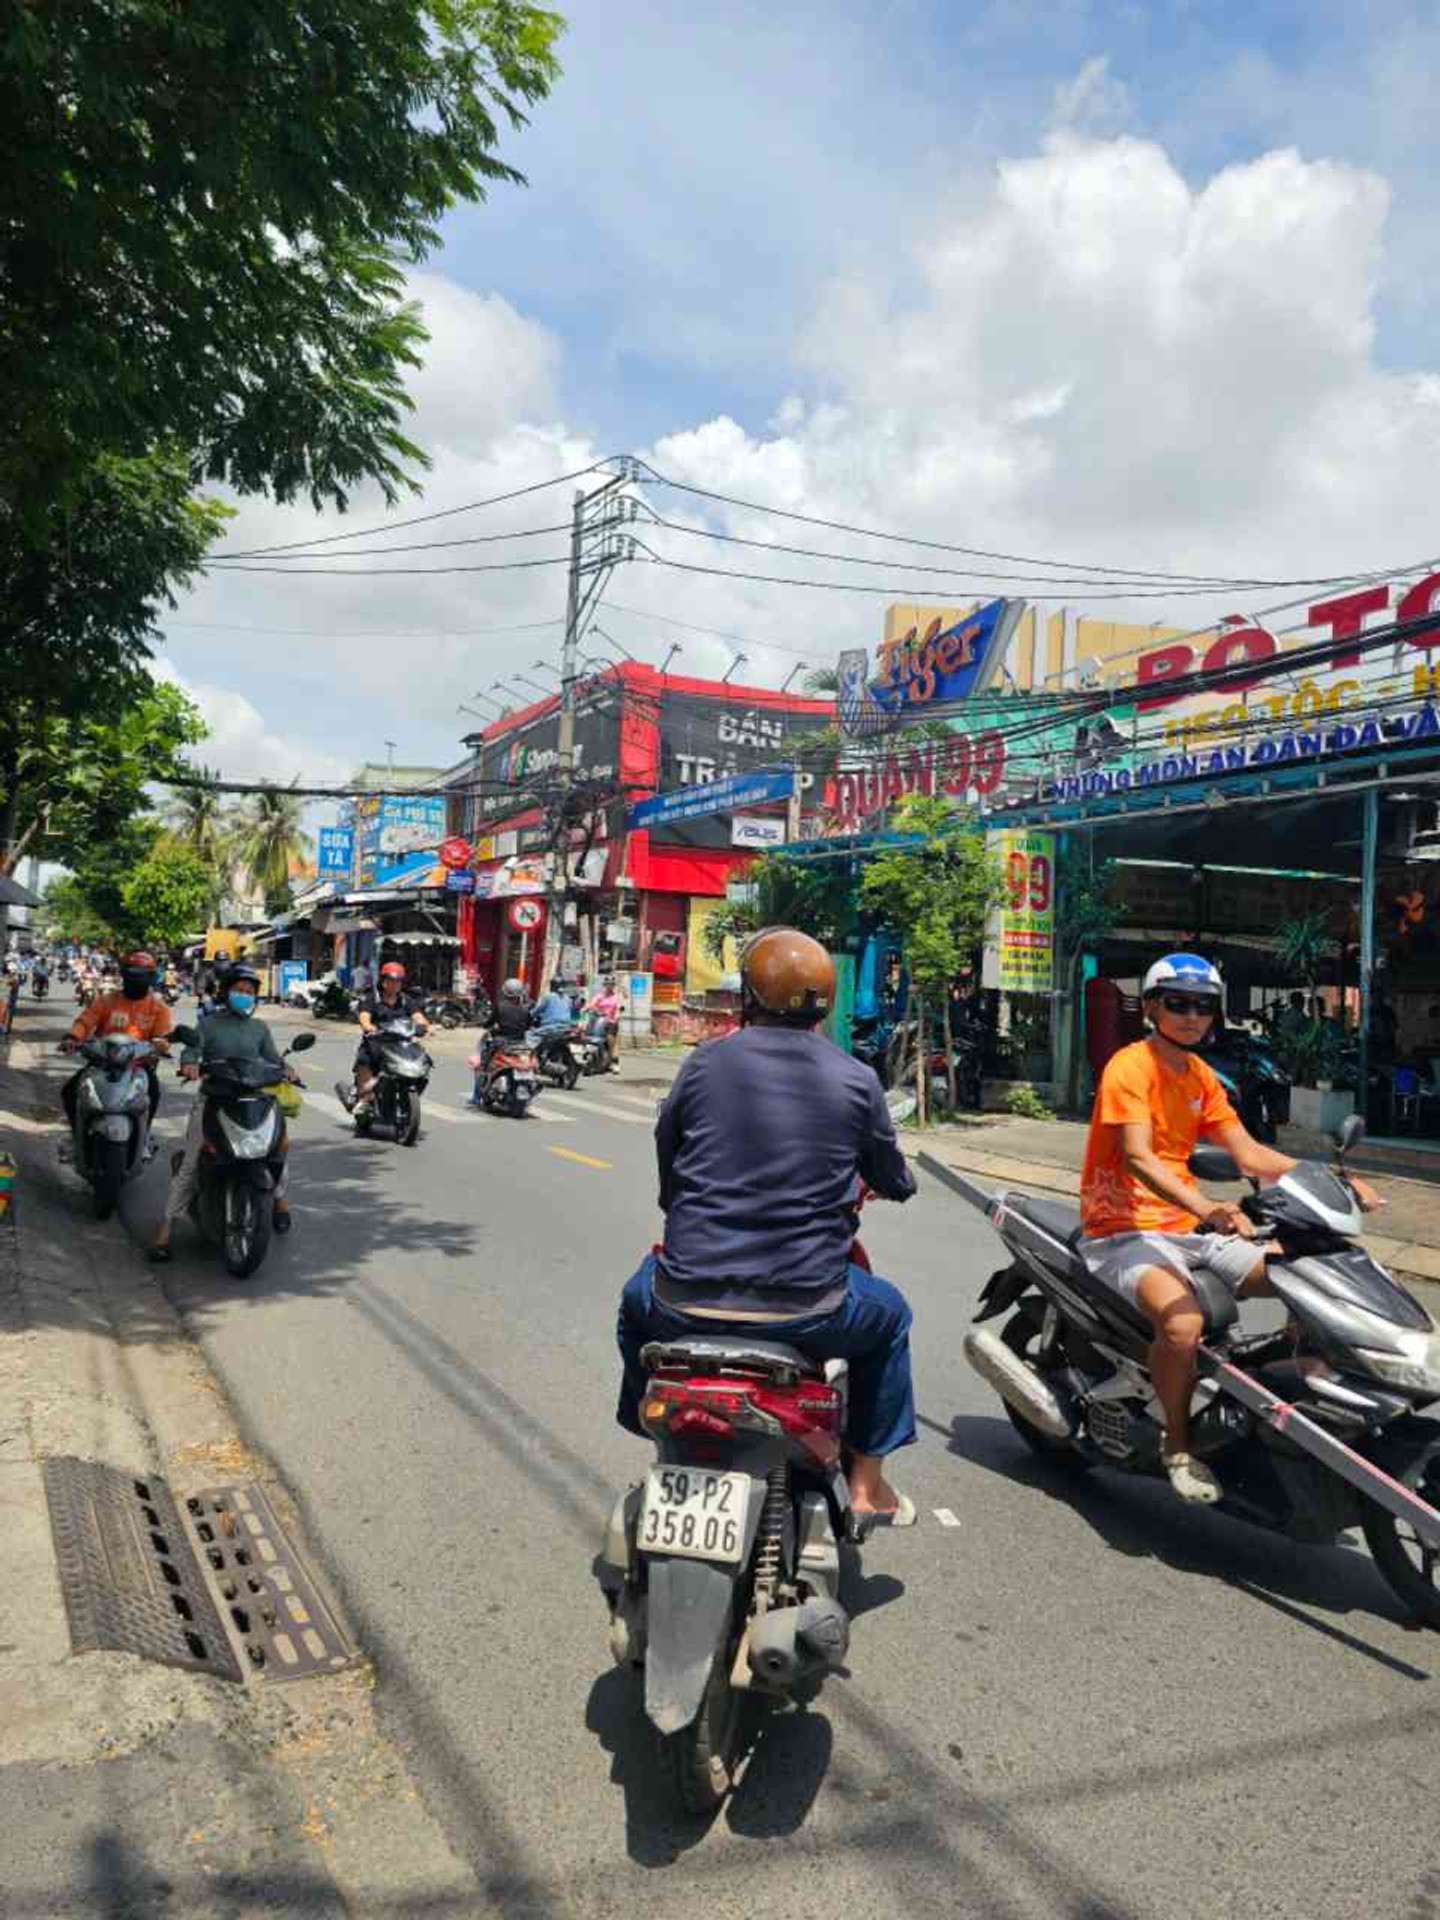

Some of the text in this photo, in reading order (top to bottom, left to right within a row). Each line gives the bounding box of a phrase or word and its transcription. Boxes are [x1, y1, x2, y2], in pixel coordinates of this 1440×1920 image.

[876, 616, 984, 704] Tiger
[718, 711, 783, 749] BÁN
[943, 730, 1008, 793] 99
[1007, 851, 1051, 914] 99
[659, 1471, 734, 1513] 59-P2
[645, 1509, 738, 1553] 358.06
